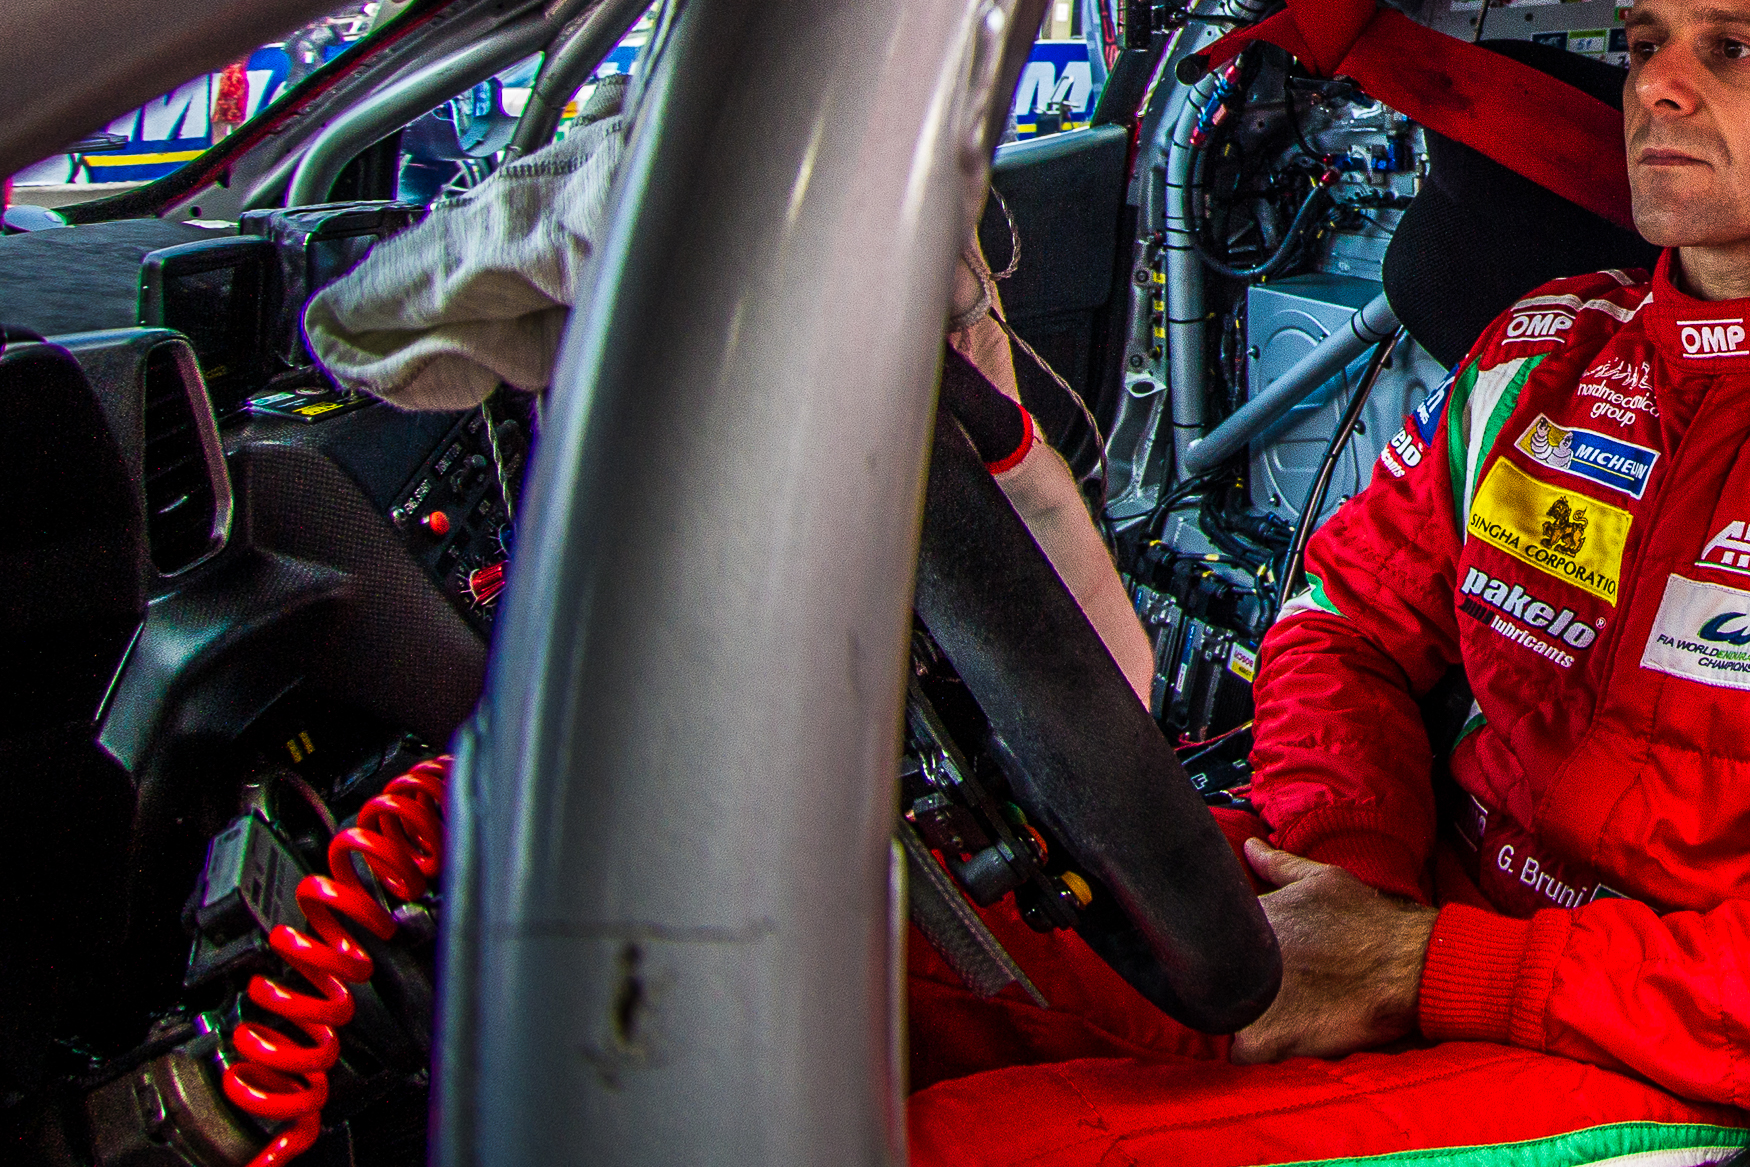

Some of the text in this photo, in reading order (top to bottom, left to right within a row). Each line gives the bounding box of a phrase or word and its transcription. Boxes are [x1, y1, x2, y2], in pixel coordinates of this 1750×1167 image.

[1507, 314, 1573, 337] OMP
[1681, 325, 1746, 353] OMP
[1590, 402, 1636, 427] group
[1574, 444, 1648, 480] MICHELIN
[1470, 513, 1616, 596] SINGHA CORPORATIO
[1459, 566, 1598, 650] pakelo
[1490, 614, 1576, 669] lubricants
[1656, 633, 1675, 649] FIA
[1497, 844, 1588, 909] G. Bruni
